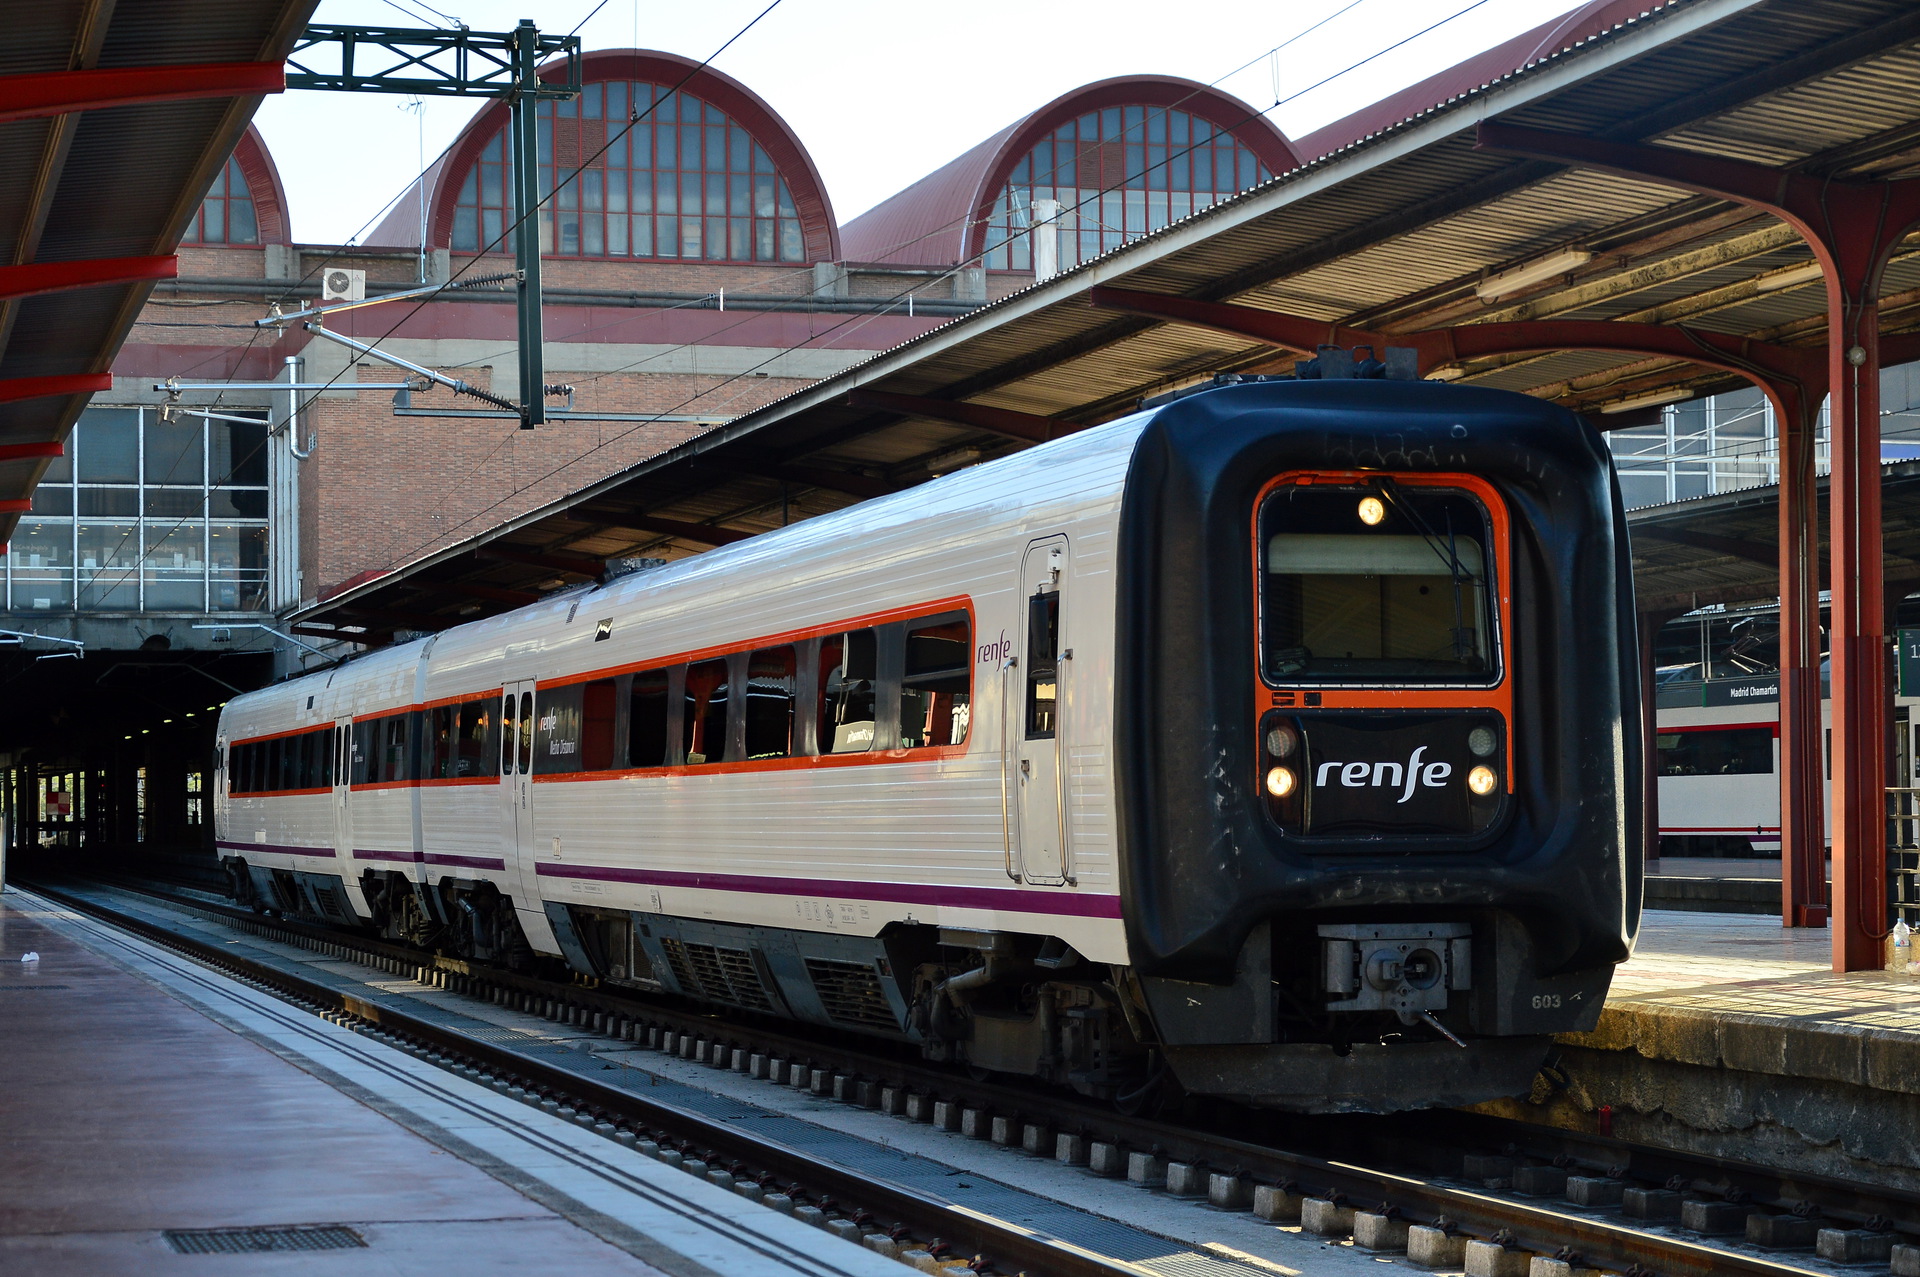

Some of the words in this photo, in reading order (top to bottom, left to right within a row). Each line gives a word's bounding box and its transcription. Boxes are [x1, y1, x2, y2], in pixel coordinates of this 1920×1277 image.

[977, 628, 1011, 672] renfe
[1911, 644, 1920, 659] 1
[1730, 686, 1749, 698] Madrid
[1750, 684, 1778, 696] Chamartín
[540, 706, 557, 739] renfe
[1316, 745, 1452, 803] renfe
[1532, 994, 1561, 1009] 603
